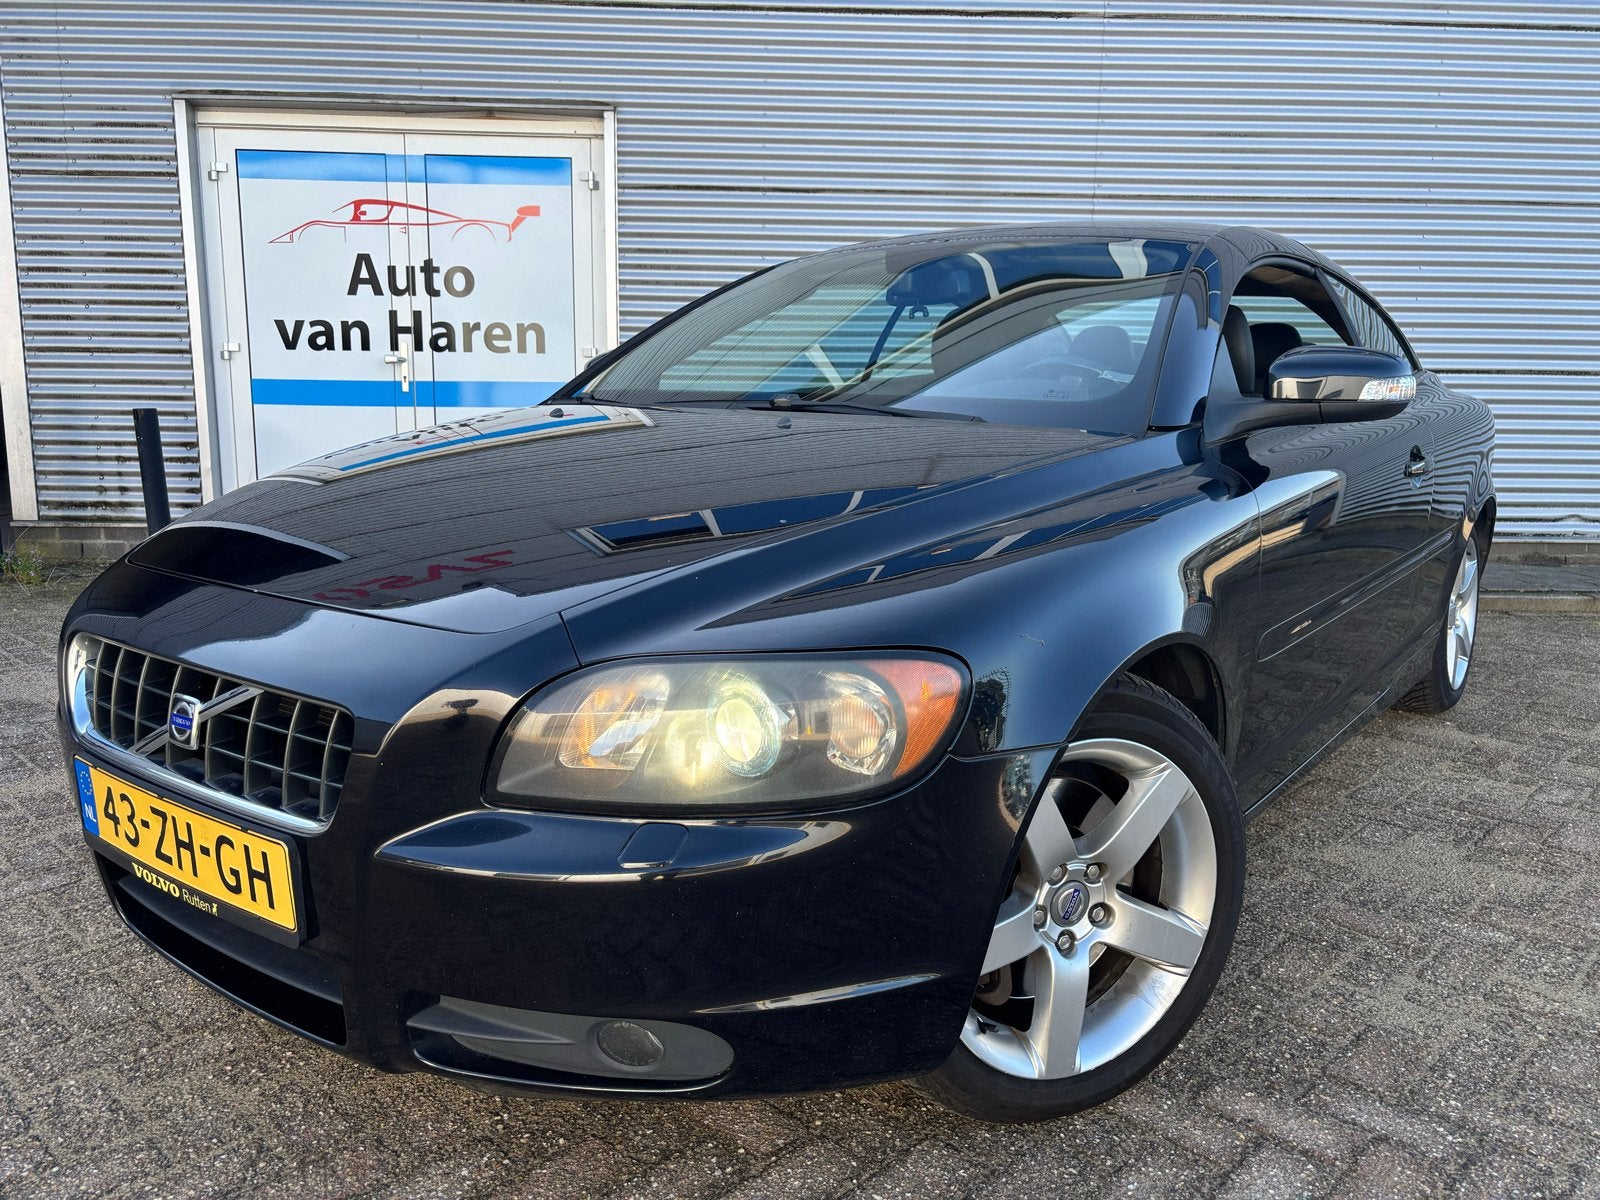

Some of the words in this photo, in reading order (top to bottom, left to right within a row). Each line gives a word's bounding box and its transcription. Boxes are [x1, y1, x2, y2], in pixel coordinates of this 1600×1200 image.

[346, 253, 475, 297] Auto
[274, 318, 371, 352] van
[388, 309, 547, 355] Haren
[85, 803, 97, 822] NL
[103, 786, 275, 910] 43-ZH-GH
[132, 862, 180, 898] VOLVO
[182, 888, 211, 914] Rutten
[1065, 891, 1079, 918] VOLVO
